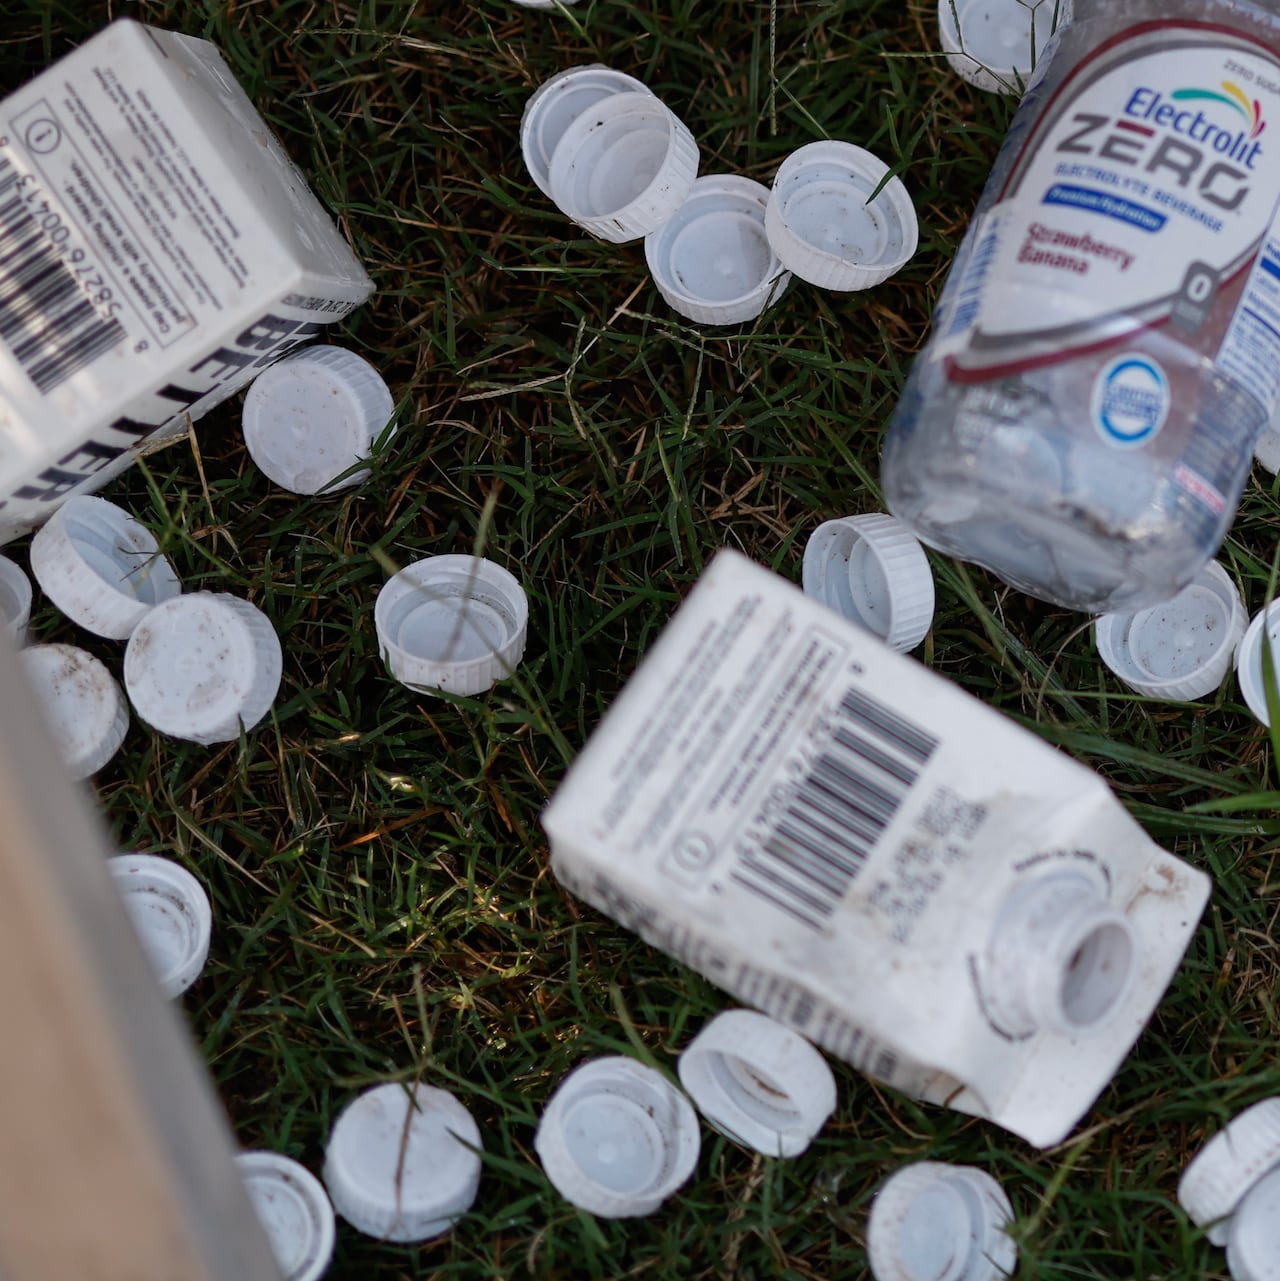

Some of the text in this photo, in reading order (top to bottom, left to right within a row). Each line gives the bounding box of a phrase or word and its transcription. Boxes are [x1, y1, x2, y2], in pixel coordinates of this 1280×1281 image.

[1222, 58, 1254, 82] ZERO
[1124, 86, 1264, 170] Electrolit
[1055, 113, 1250, 212] ZERO
[1153, 188, 1224, 233] BEVERAGE
[1028, 222, 1135, 270] Strawberry
[1187, 273, 1212, 302] 0
